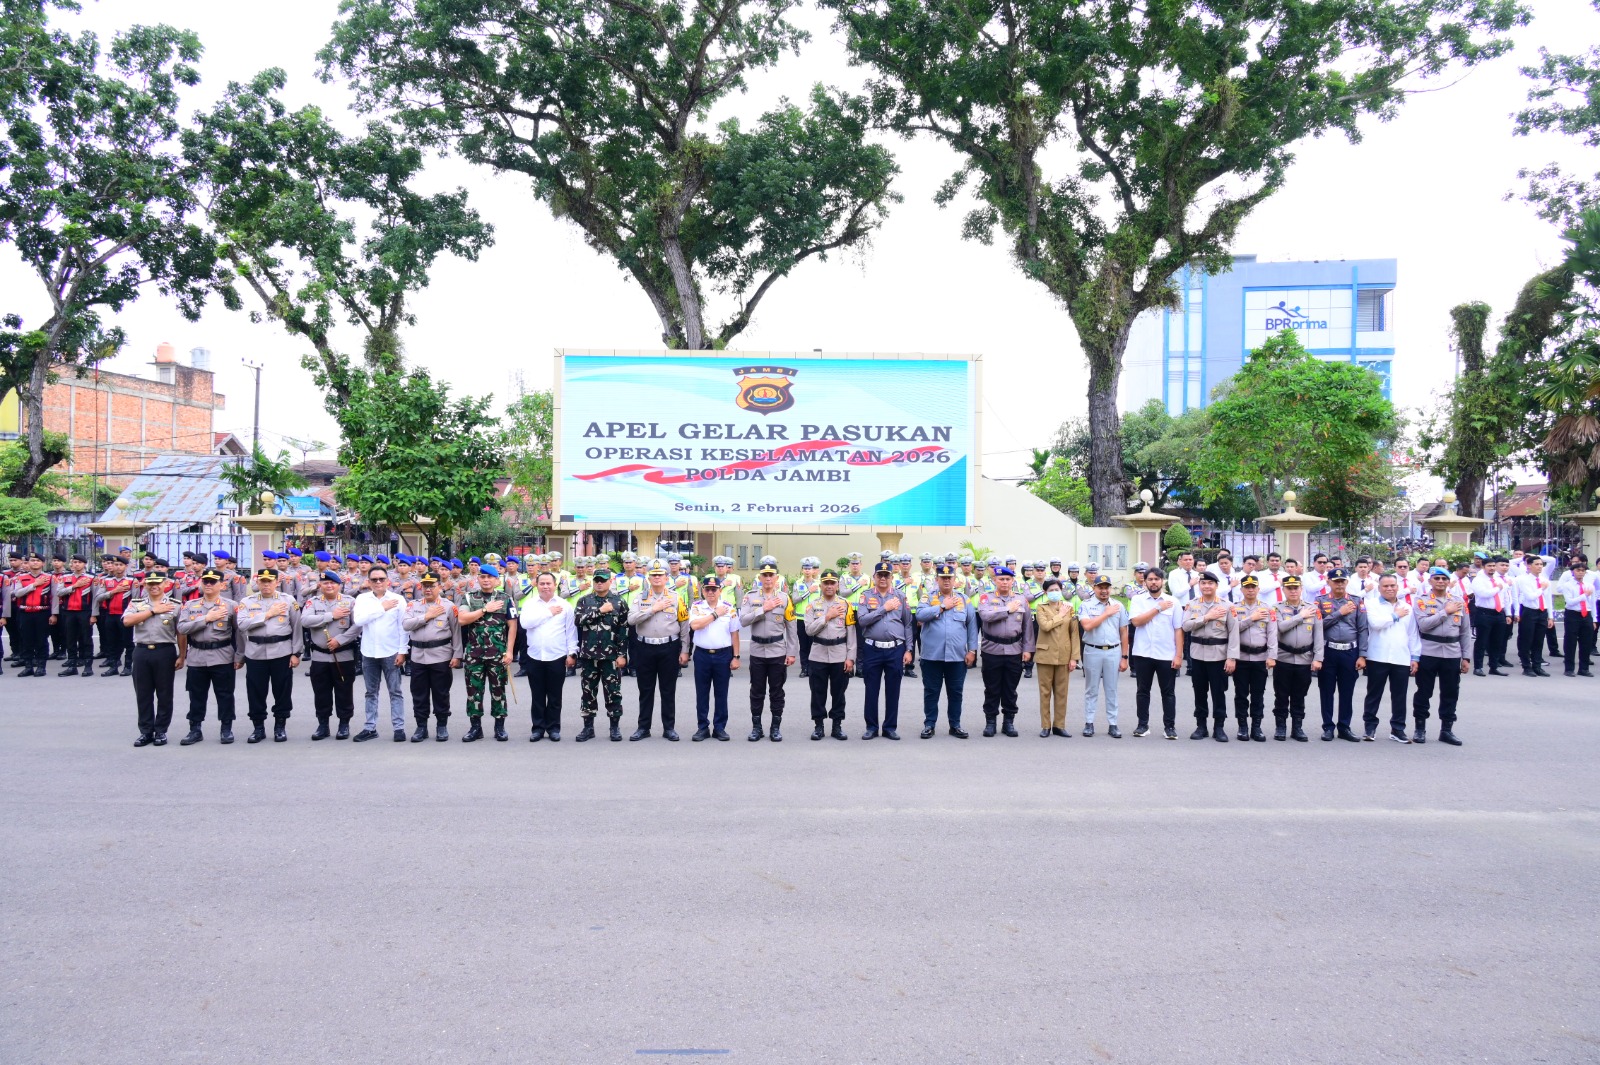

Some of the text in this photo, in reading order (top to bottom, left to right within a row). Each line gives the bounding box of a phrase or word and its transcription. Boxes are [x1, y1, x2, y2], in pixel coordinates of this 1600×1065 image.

[738, 367, 793, 375] JAMBI
[582, 421, 953, 442] APEL GELAR PASUKAN
[584, 447, 951, 464] OPERASI KESELAMATAN 2026
[685, 468, 851, 482] POLDA JAMBI
[674, 502, 861, 514] Senin, 2 Februari 2026
